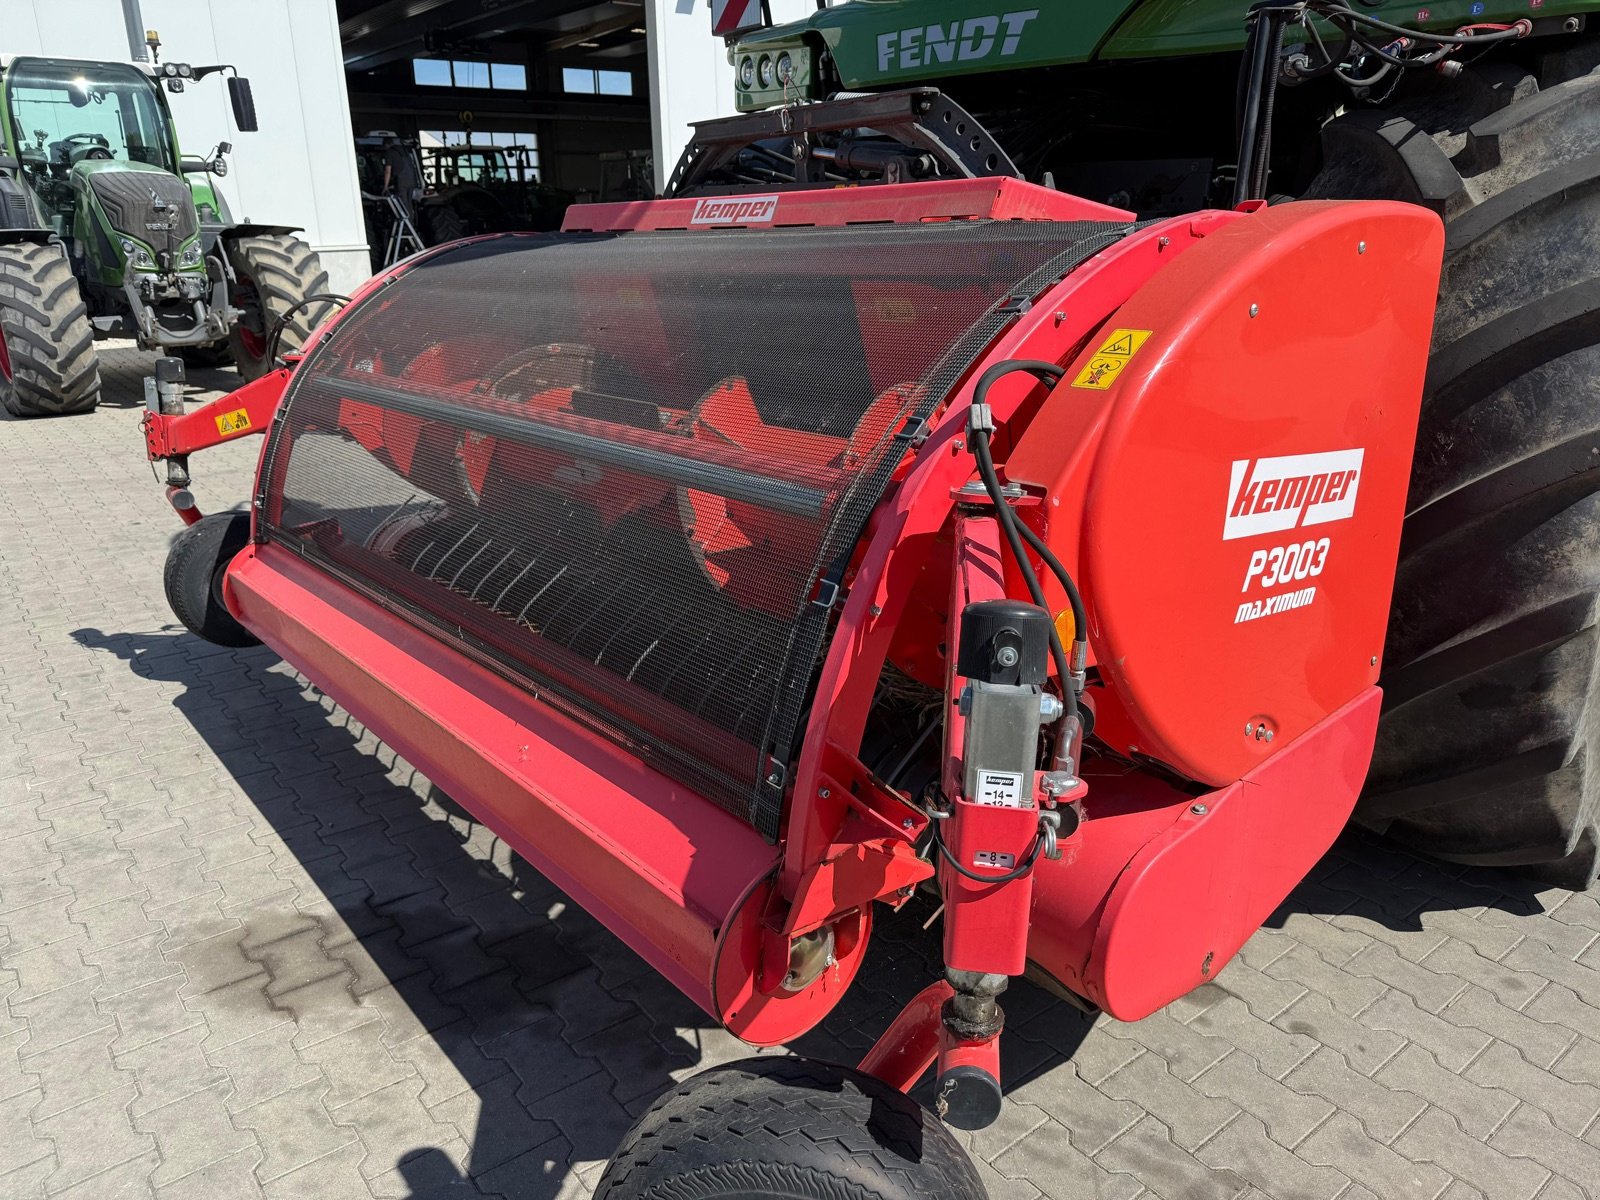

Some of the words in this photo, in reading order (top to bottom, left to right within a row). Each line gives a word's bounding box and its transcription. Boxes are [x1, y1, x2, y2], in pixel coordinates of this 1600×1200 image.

[876, 9, 1040, 72] FENDT
[693, 198, 776, 223] kemper
[1229, 459, 1358, 528] kemper
[1241, 537, 1331, 593] P3003
[985, 776, 1015, 787] kemper
[990, 851, 997, 861] 8
